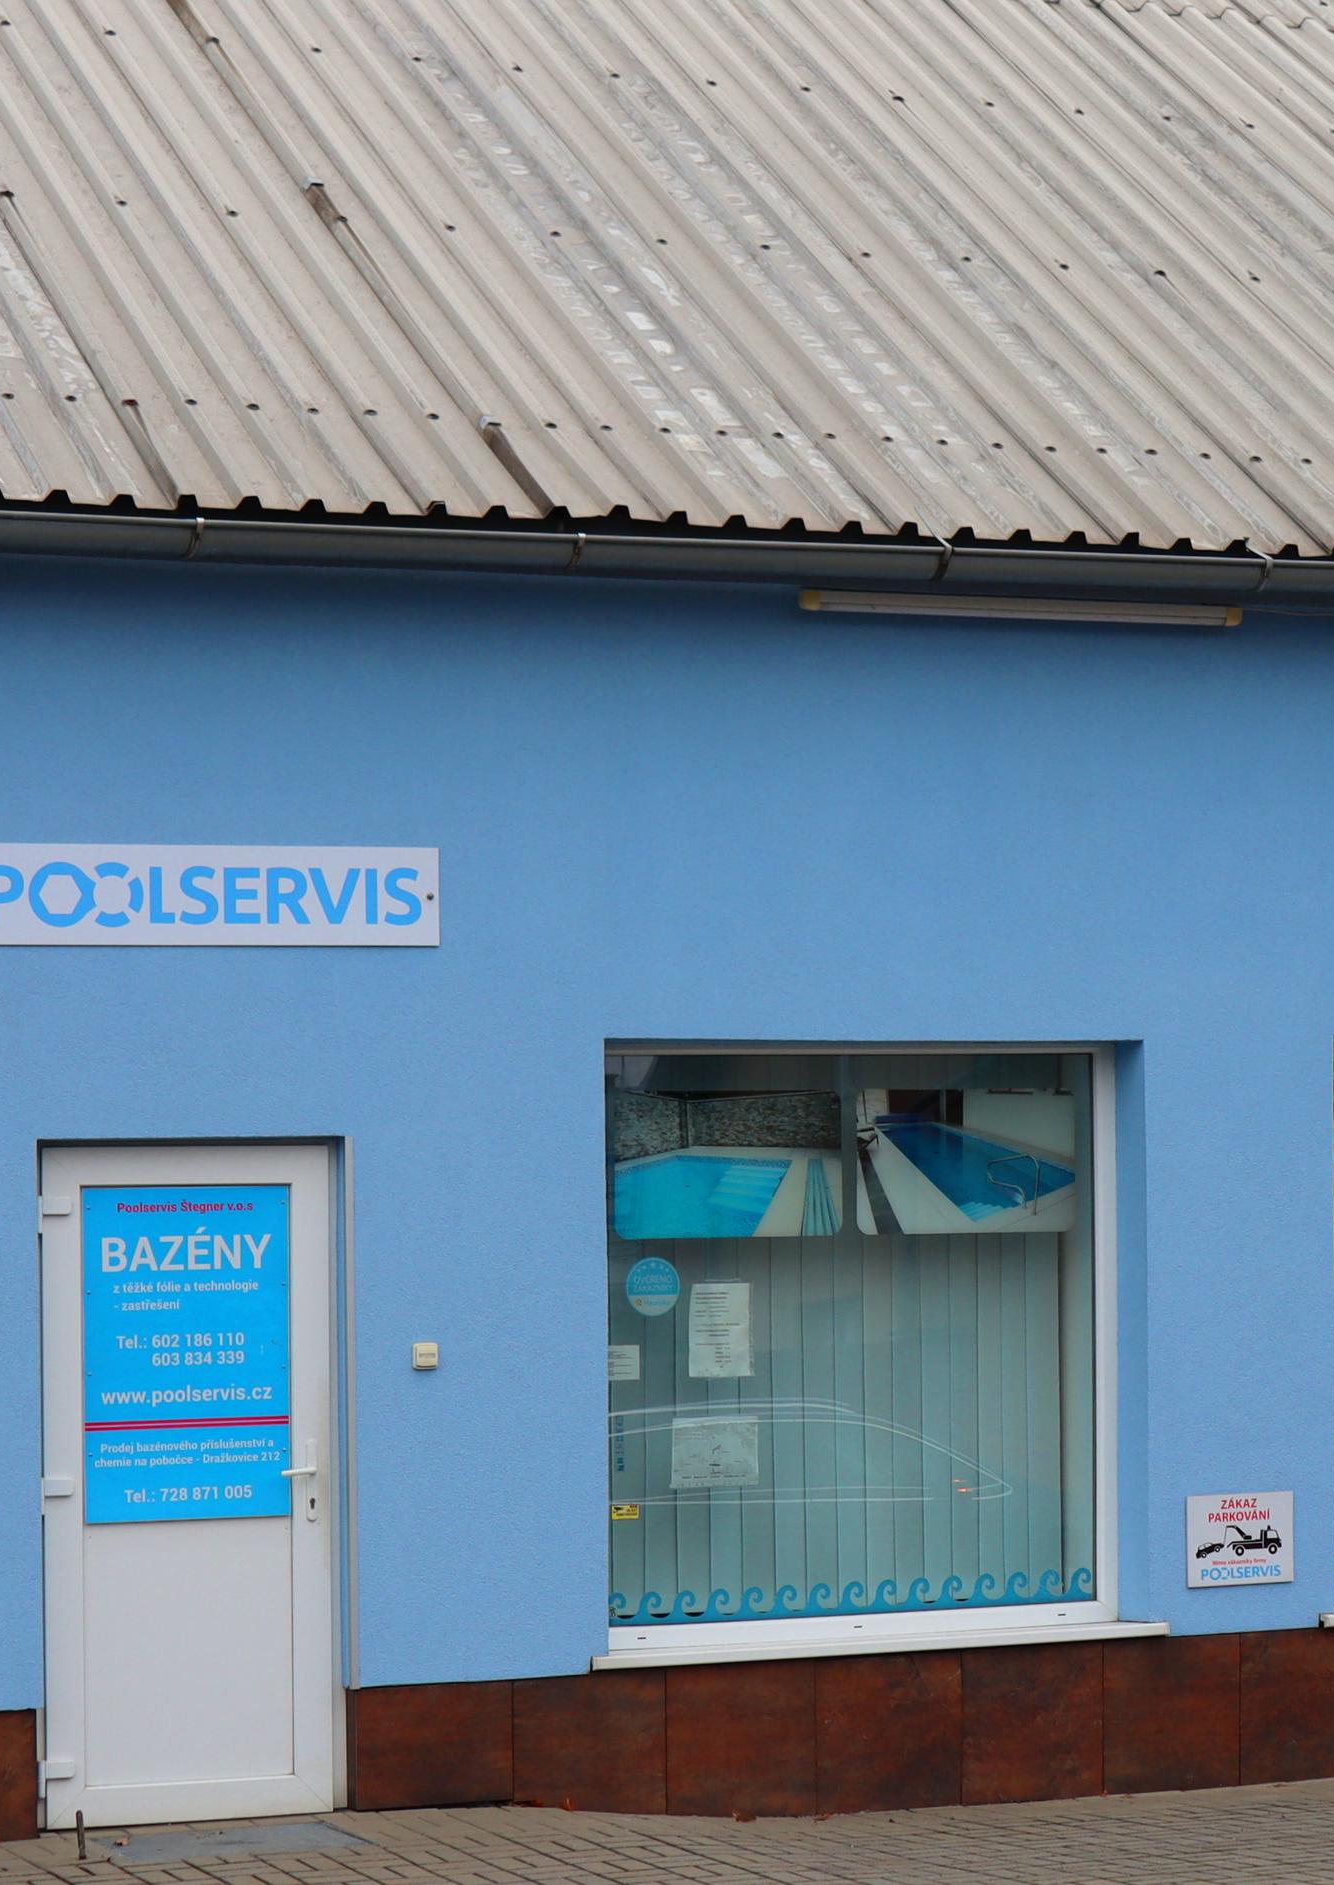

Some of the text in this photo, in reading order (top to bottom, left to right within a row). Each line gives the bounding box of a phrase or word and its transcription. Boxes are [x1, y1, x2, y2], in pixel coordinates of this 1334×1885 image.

[117, 1201, 178, 1214] Poolservis
[180, 1199, 225, 1214] Štegner
[101, 1226, 272, 1273] BAZÉNY
[113, 1279, 259, 1294] z těžké fólie a technologie
[122, 1299, 180, 1311] zastřešení
[116, 1332, 245, 1349] Tel.: 602 186 110
[152, 1350, 245, 1366] 603 834 339
[101, 1384, 273, 1407] www.poolservis.cz
[100, 1438, 274, 1454] Prodej bazénového příslušenství a
[94, 1457, 132, 1468] chemie
[134, 1458, 147, 1466] na
[149, 1454, 193, 1468] pobočce
[203, 1452, 259, 1464] Dražkovice
[261, 1451, 281, 1462] 212
[124, 1485, 252, 1503] Tel.: 728 871 005
[1221, 1497, 1258, 1510] ZÁKAZ
[1208, 1508, 1271, 1523] PARKOVÁNÍ
[1201, 1565, 1281, 1580] POOLSERVIS
